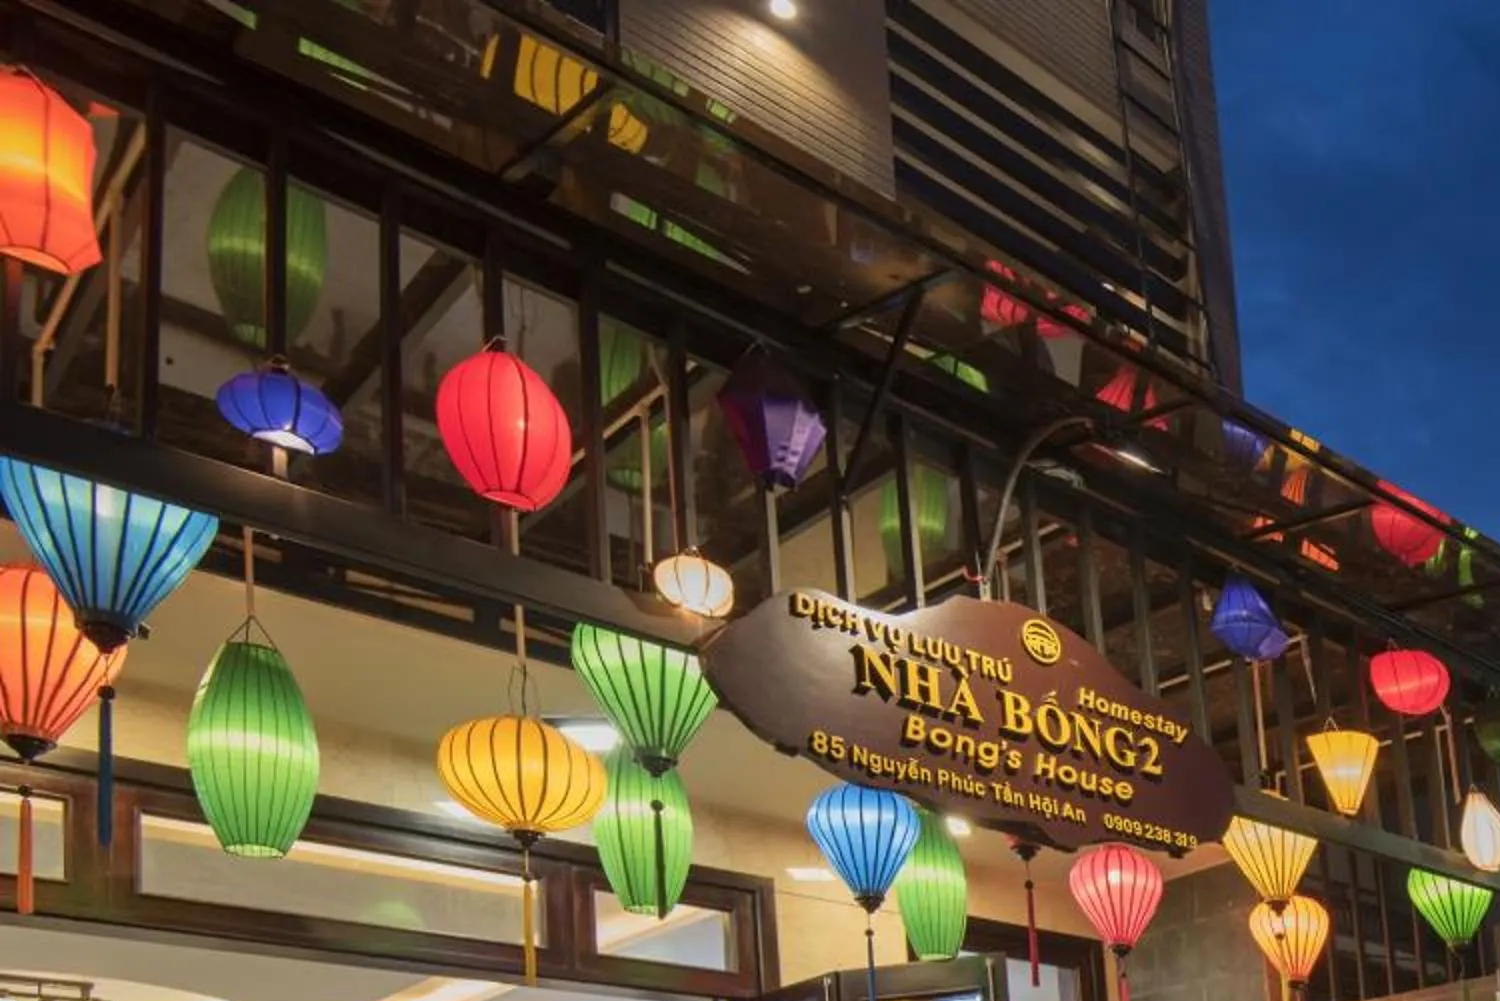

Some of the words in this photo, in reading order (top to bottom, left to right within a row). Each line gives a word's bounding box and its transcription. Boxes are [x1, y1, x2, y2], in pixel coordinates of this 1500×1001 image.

[855, 643, 984, 723] NHÀ
[965, 649, 1013, 682] TRÚ
[1079, 687, 1188, 743] Homestay
[812, 730, 846, 760] 85
[937, 768, 986, 796] Phúc
[1063, 801, 1086, 823] An
[1103, 813, 1142, 836] 0909
[905, 714, 1022, 768] Bong's
[1036, 752, 1134, 800] House
